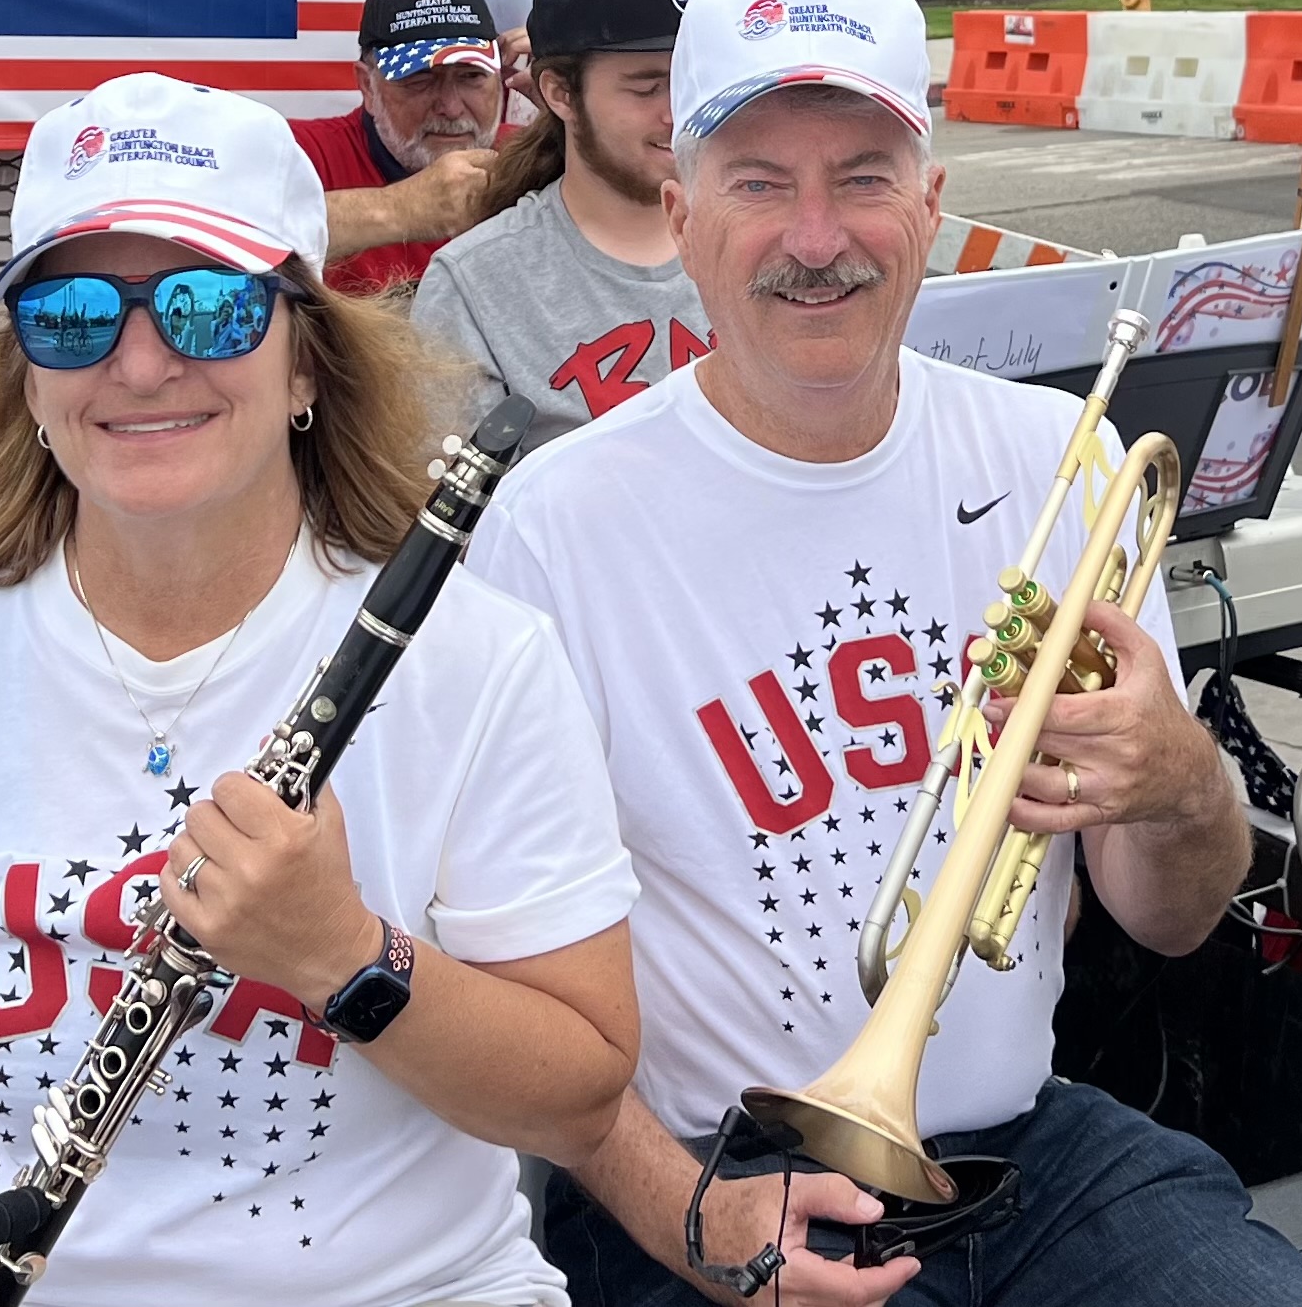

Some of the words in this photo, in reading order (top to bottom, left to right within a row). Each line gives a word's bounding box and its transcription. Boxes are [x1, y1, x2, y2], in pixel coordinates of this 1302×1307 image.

[396, 6, 448, 20] HUNTINGTON
[788, 4, 828, 15] GREATER
[389, 14, 445, 33] INTERFAITH
[447, 14, 481, 24] COUNCIL
[789, 14, 847, 25] HUNTINGTON
[849, 18, 872, 34] BEACH
[790, 23, 843, 32] INTERFAITH
[845, 26, 877, 44] COUNCIL
[110, 128, 157, 141] GREATER
[110, 140, 178, 153] HUNTINGTON
[181, 145, 214, 158] BEACH
[108, 151, 172, 163] INTERFAITH
[175, 155, 219, 169] COUNCIL
[960, 337, 988, 369] of
[986, 330, 1042, 374] July
[693, 631, 1000, 837] US
